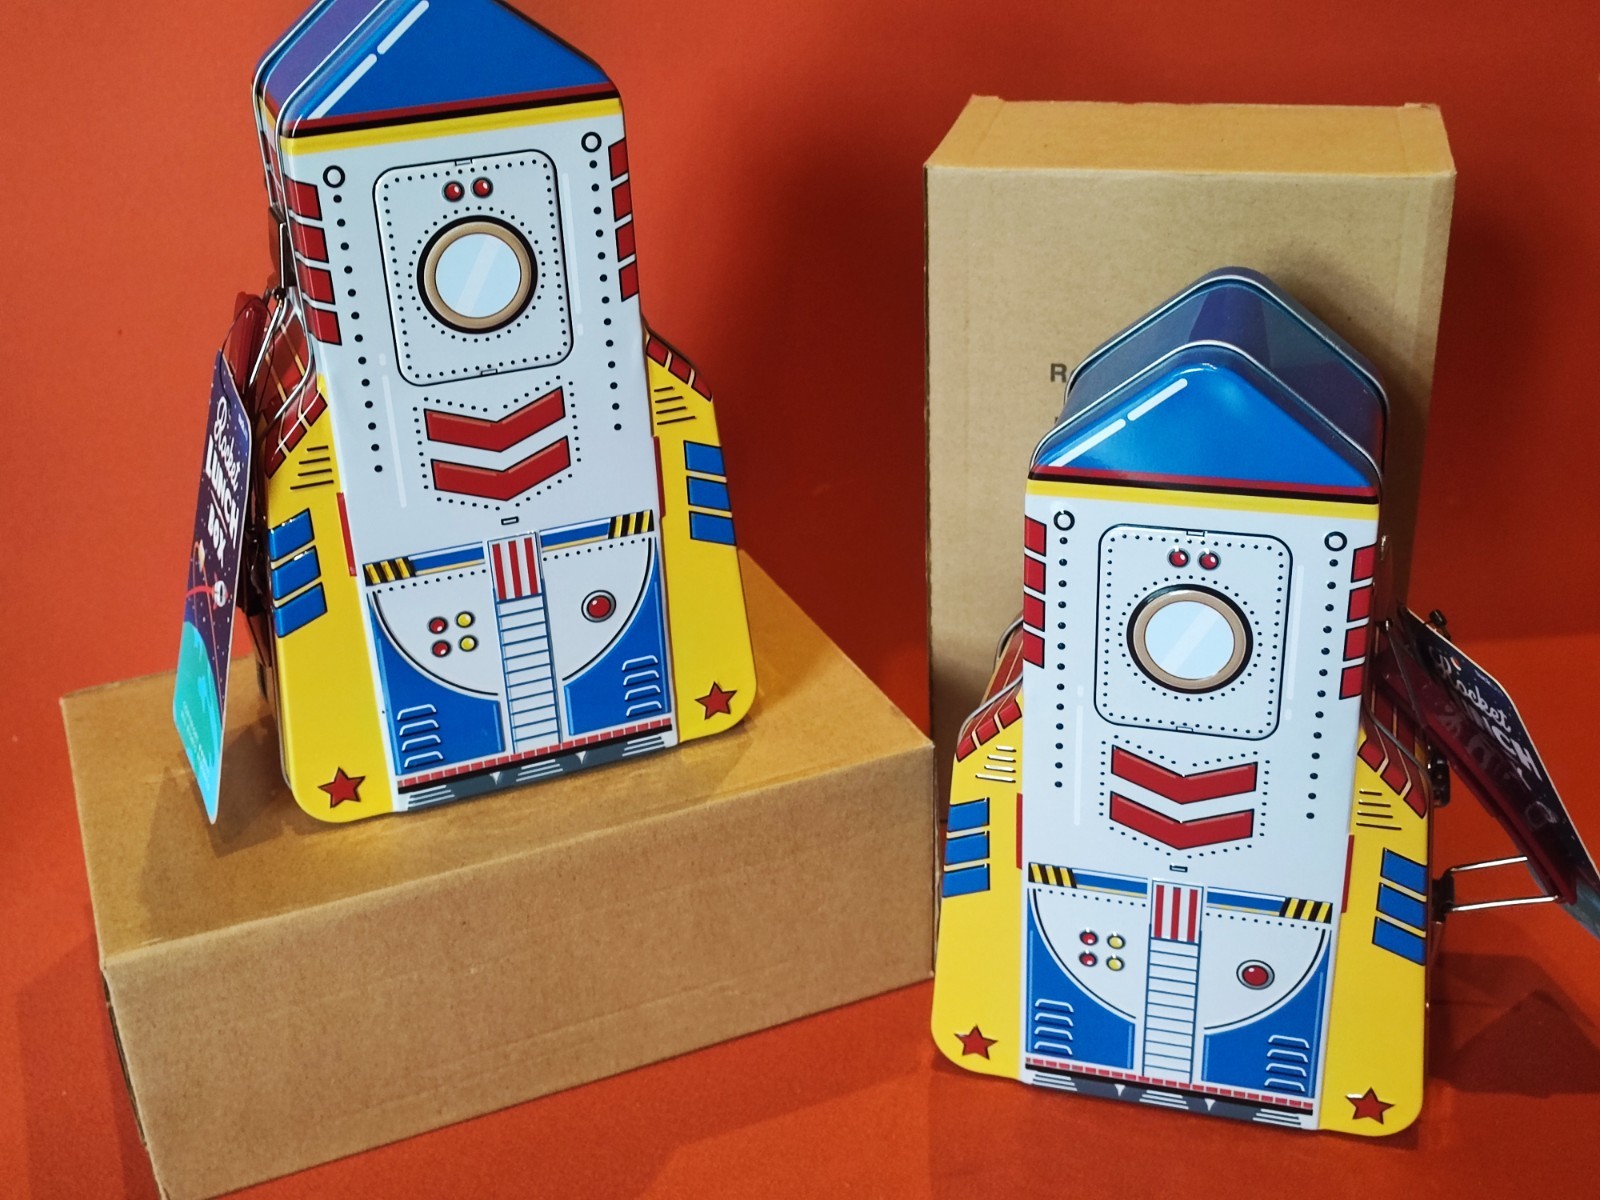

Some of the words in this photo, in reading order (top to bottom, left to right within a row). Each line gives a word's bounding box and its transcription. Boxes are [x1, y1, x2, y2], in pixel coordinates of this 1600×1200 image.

[213, 396, 241, 491] Rocket
[205, 434, 240, 549] LUNCH
[207, 503, 227, 568] BOX
